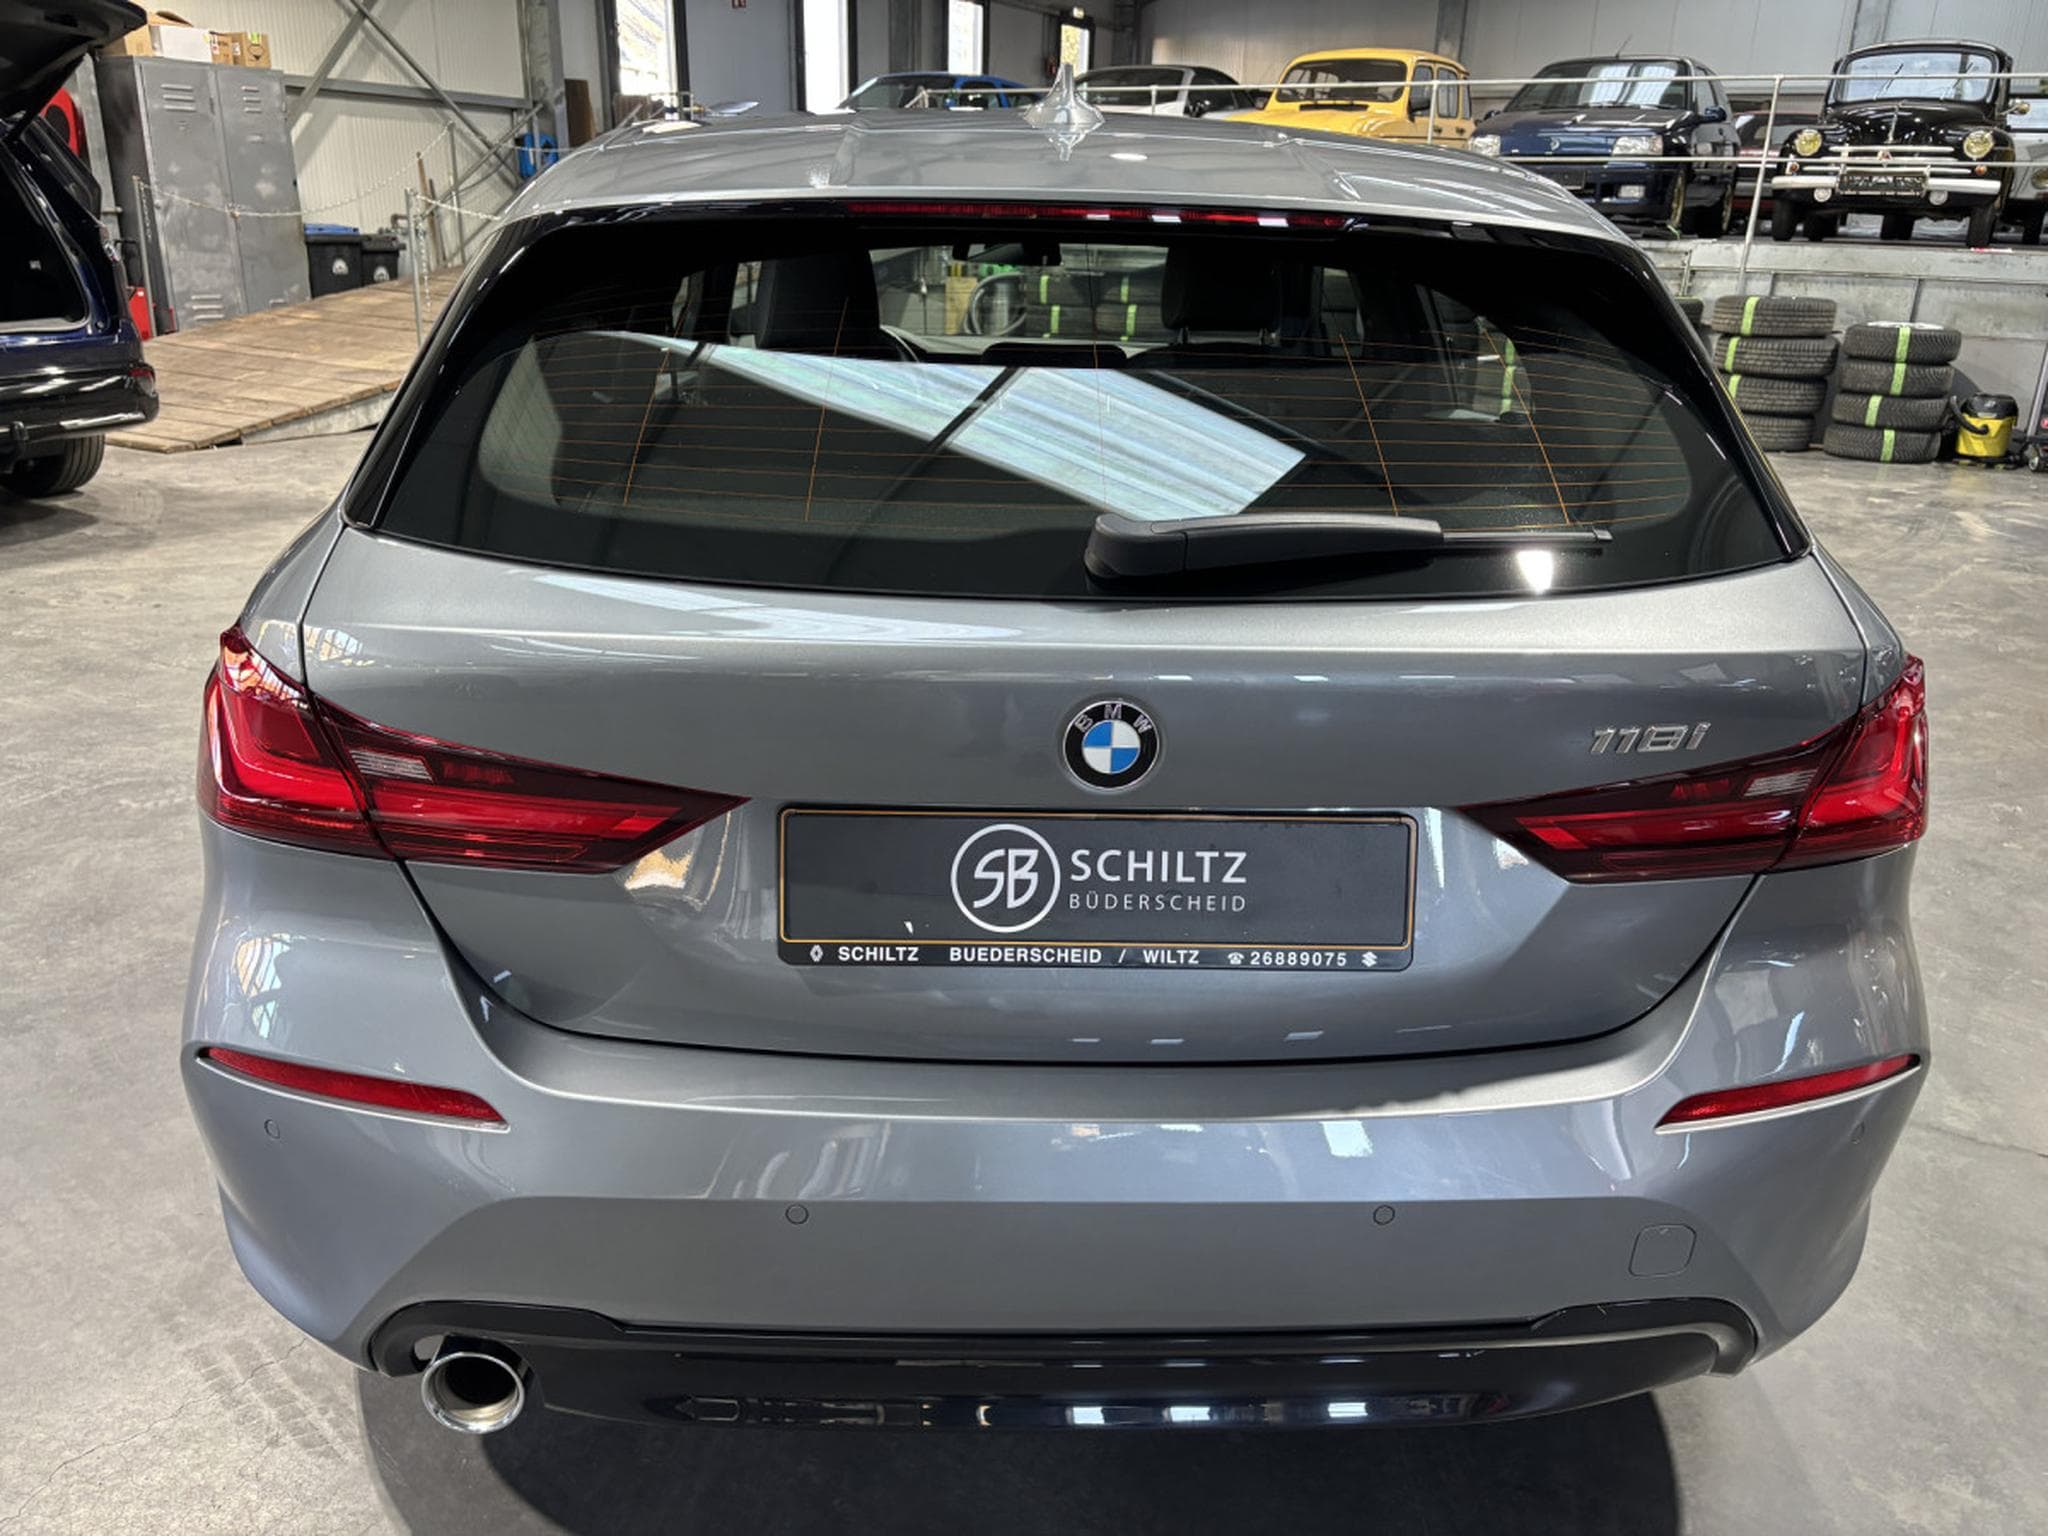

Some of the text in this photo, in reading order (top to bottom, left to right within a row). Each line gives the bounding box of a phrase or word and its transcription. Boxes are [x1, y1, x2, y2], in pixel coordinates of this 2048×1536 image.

[1074, 703, 1153, 734] BMW
[1590, 722, 1712, 754] 118i
[973, 849, 1039, 909] SB
[1070, 849, 1247, 883] SCHILTZ
[1069, 890, 1246, 912] BÜDERSCHEID
[838, 946, 1347, 967] SCHILTZ BUEDERSCHEID / WILTZ 26889075
